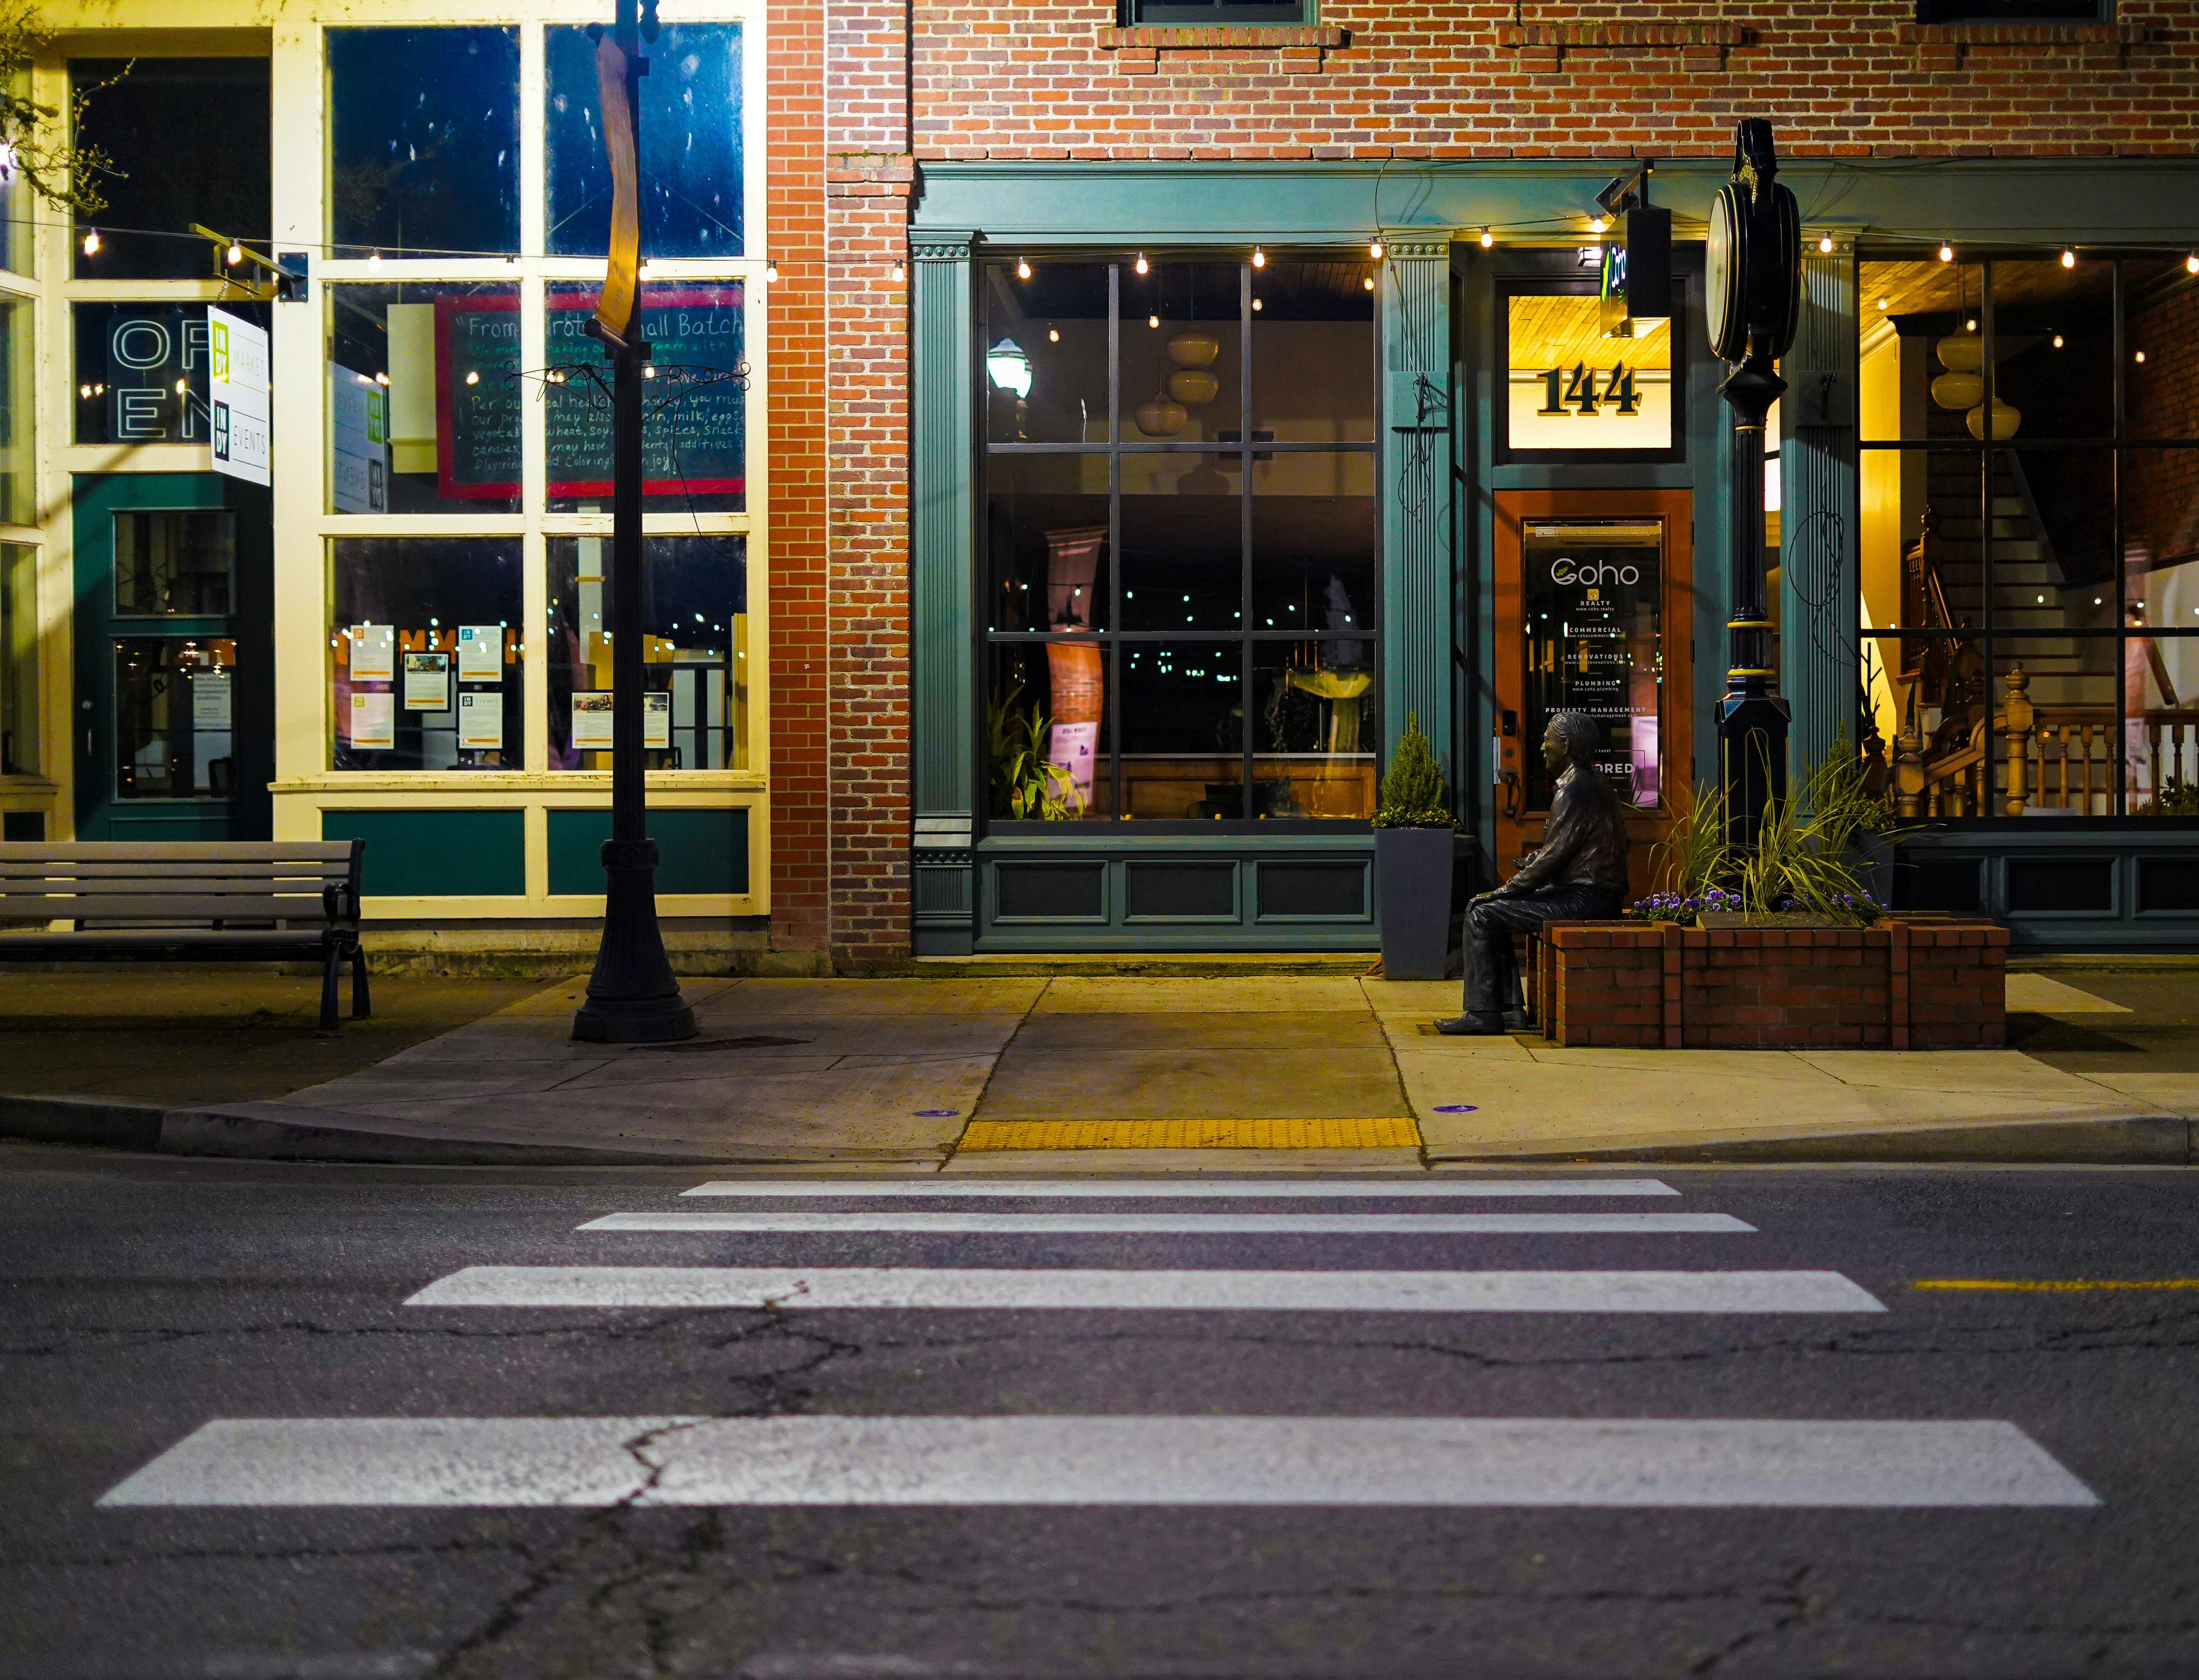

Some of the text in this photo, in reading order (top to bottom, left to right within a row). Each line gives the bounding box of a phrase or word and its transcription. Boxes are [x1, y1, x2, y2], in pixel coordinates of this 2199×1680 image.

[679, 310, 743, 336] Batch
[233, 349, 265, 376] MARKET
[1537, 359, 1643, 416] 144
[690, 395, 711, 408] you
[233, 425, 265, 454] EVENTS
[1551, 558, 1639, 585] Coho
